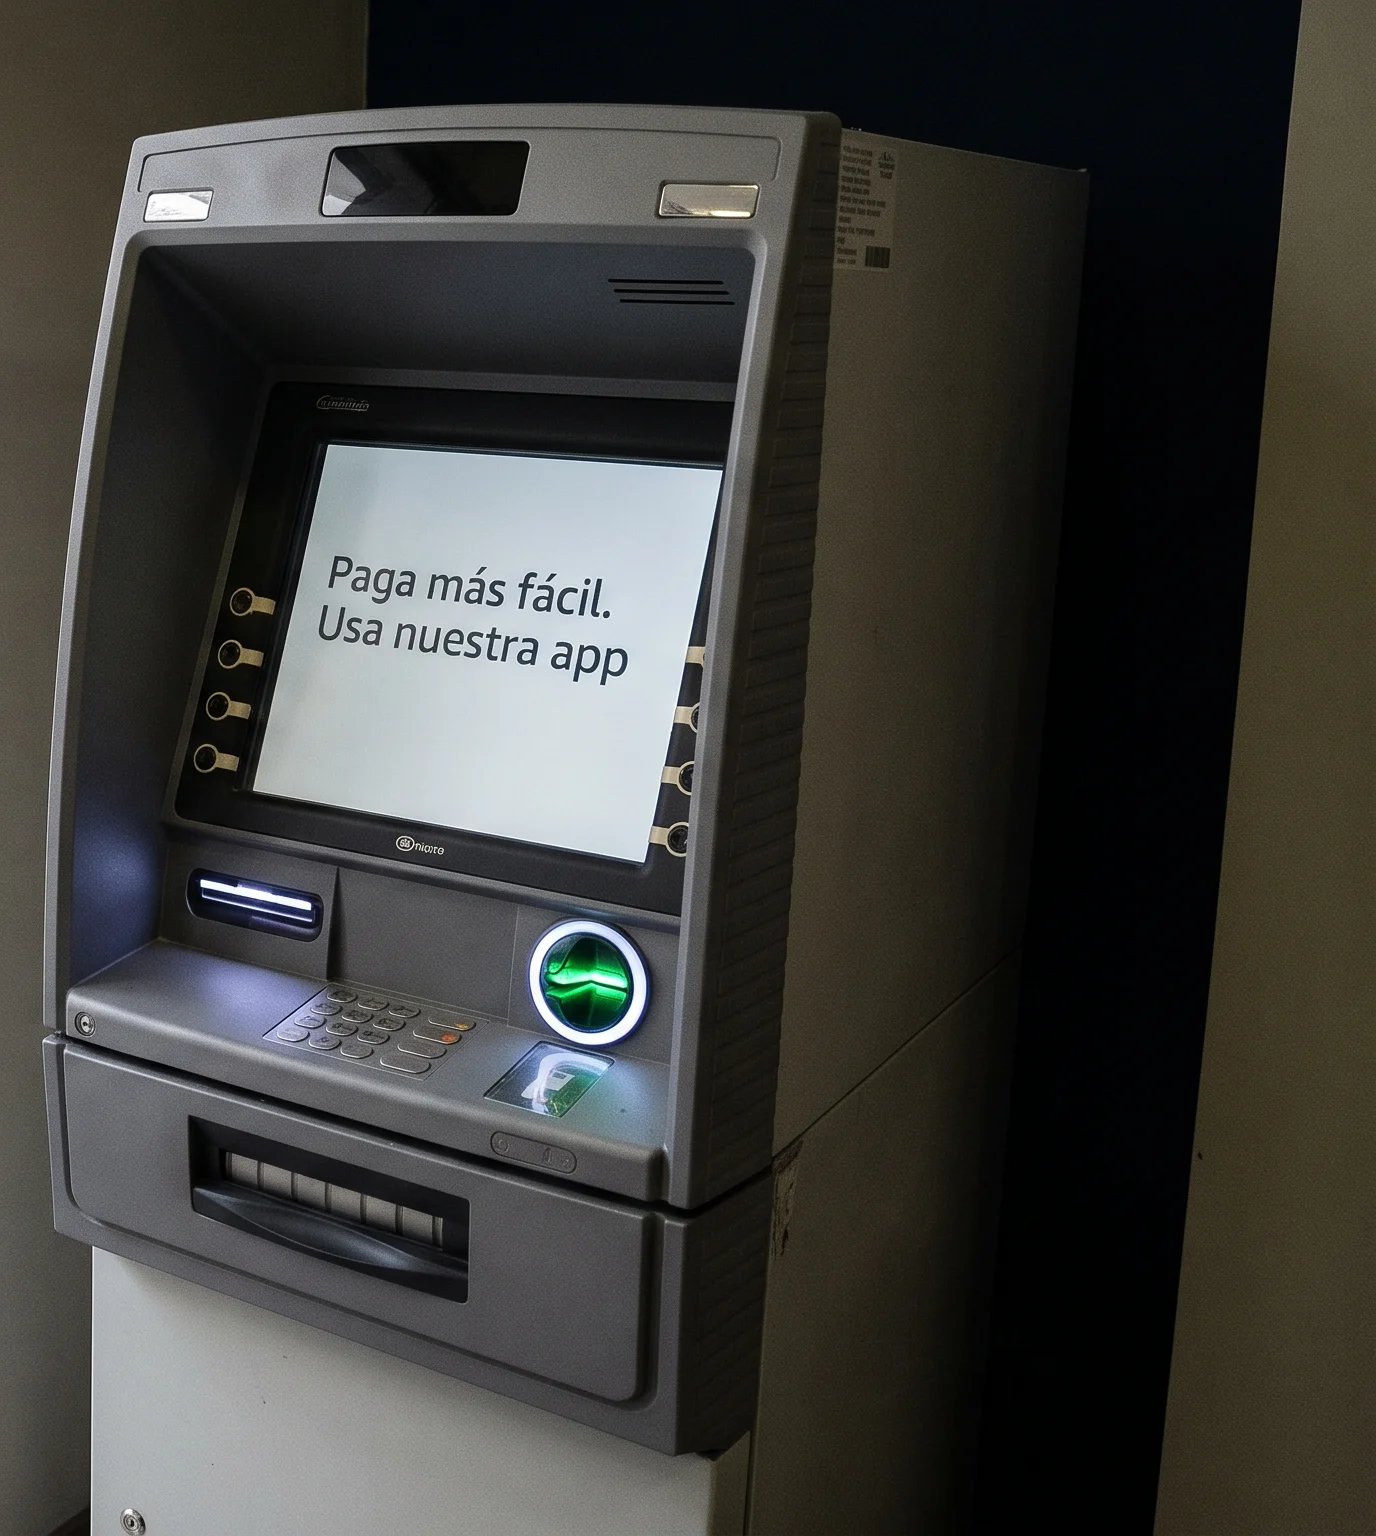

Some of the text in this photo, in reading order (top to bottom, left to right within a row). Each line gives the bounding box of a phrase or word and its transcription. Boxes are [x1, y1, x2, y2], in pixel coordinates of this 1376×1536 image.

[327, 555, 612, 619] Paga más fácil.
[318, 604, 630, 686] Usa nuestra app
